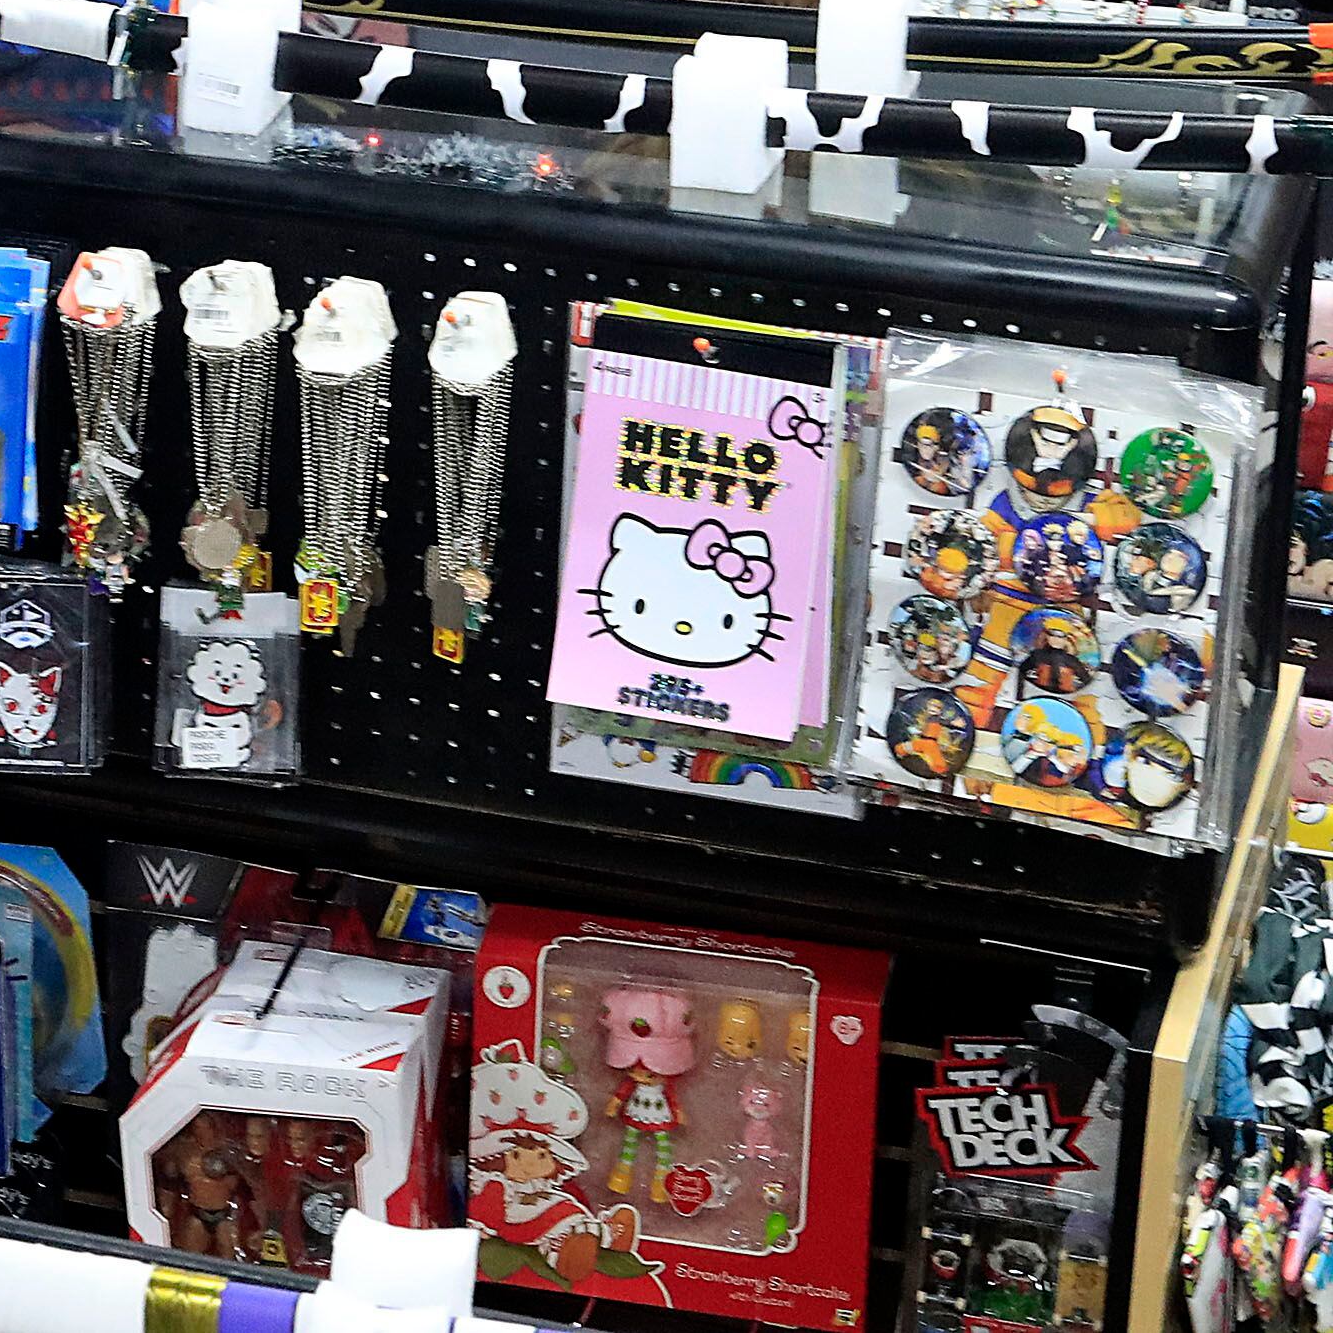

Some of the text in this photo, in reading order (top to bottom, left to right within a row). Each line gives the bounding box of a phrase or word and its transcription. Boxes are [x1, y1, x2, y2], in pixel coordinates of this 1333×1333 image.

[620, 418, 782, 478] HELLO
[614, 458, 783, 514] KITTY
[617, 686, 731, 722] STICKERS
[579, 920, 691, 949] Strawberry
[277, 1070, 369, 1099] ROCK
[927, 1094, 1054, 1134] TECH
[947, 1127, 1074, 1168] DECK
[674, 1262, 767, 1294] Strawberry
